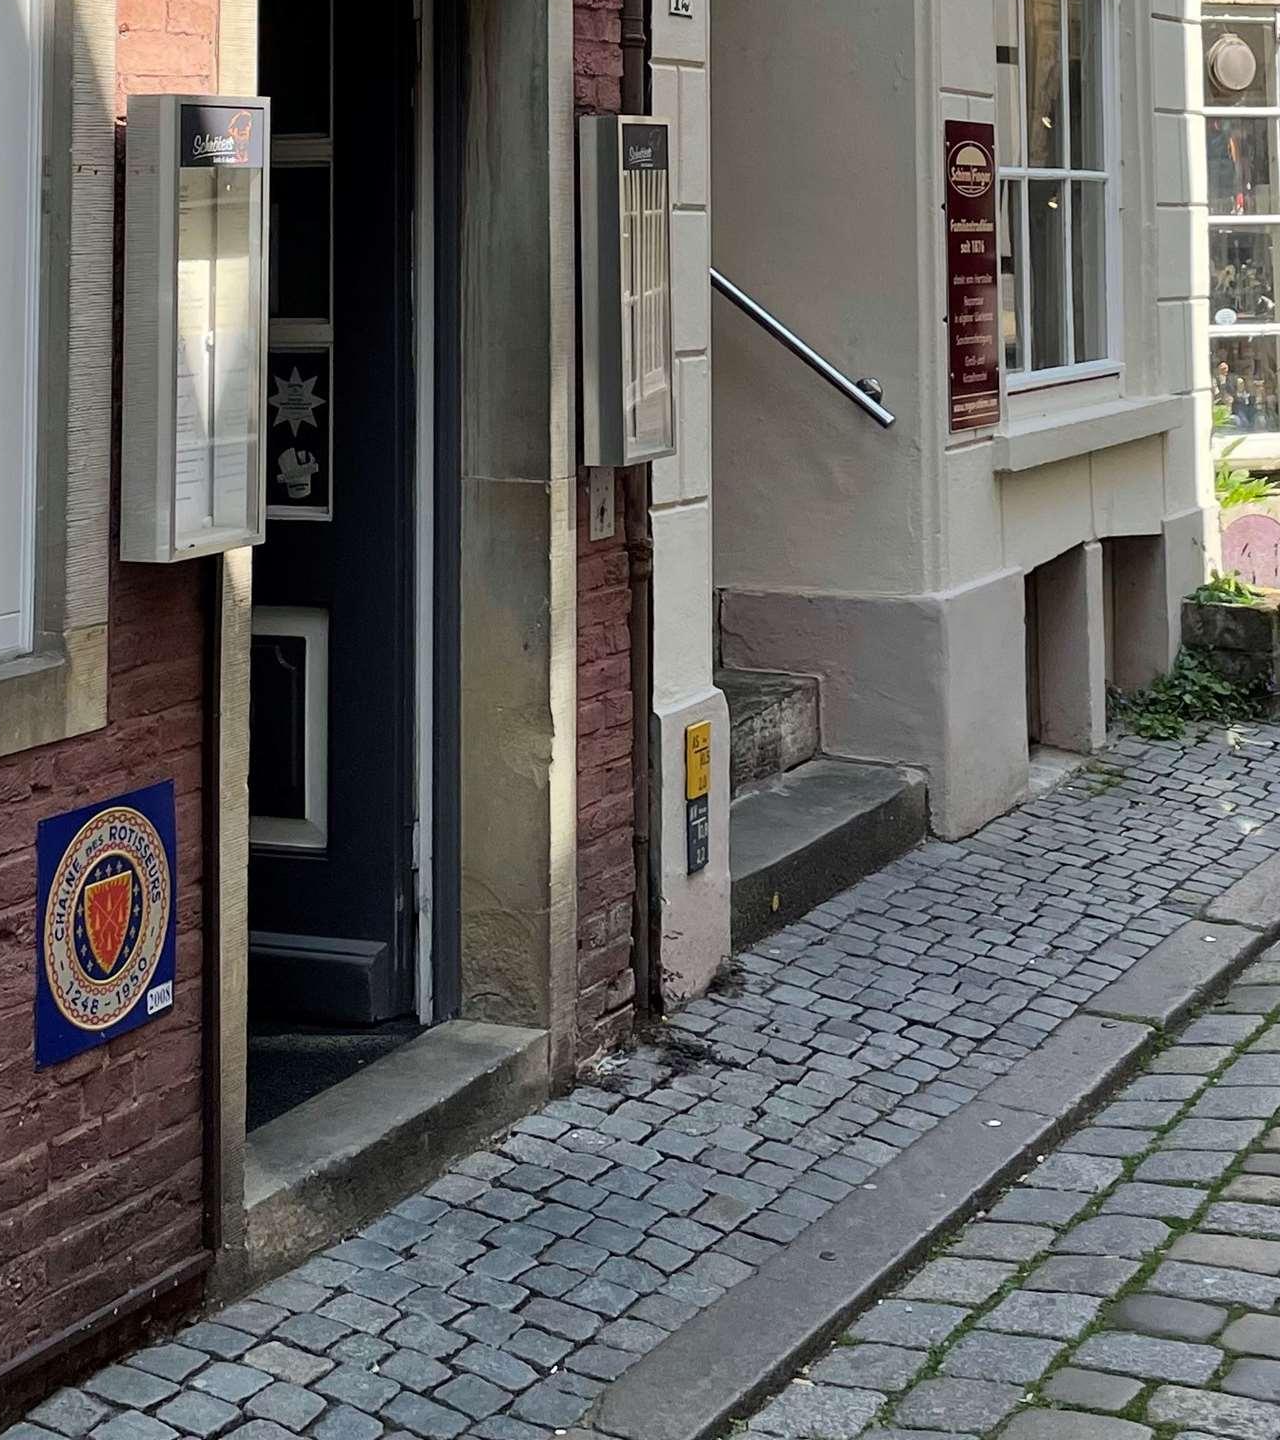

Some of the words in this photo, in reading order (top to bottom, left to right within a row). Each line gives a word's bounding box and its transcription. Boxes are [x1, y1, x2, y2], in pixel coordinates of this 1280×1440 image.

[54, 859, 82, 942] CHAINE
[85, 834, 105, 859] DES
[108, 825, 161, 905] ROTISSEURS
[65, 980, 100, 1015] 1248
[115, 956, 148, 1006] 1950
